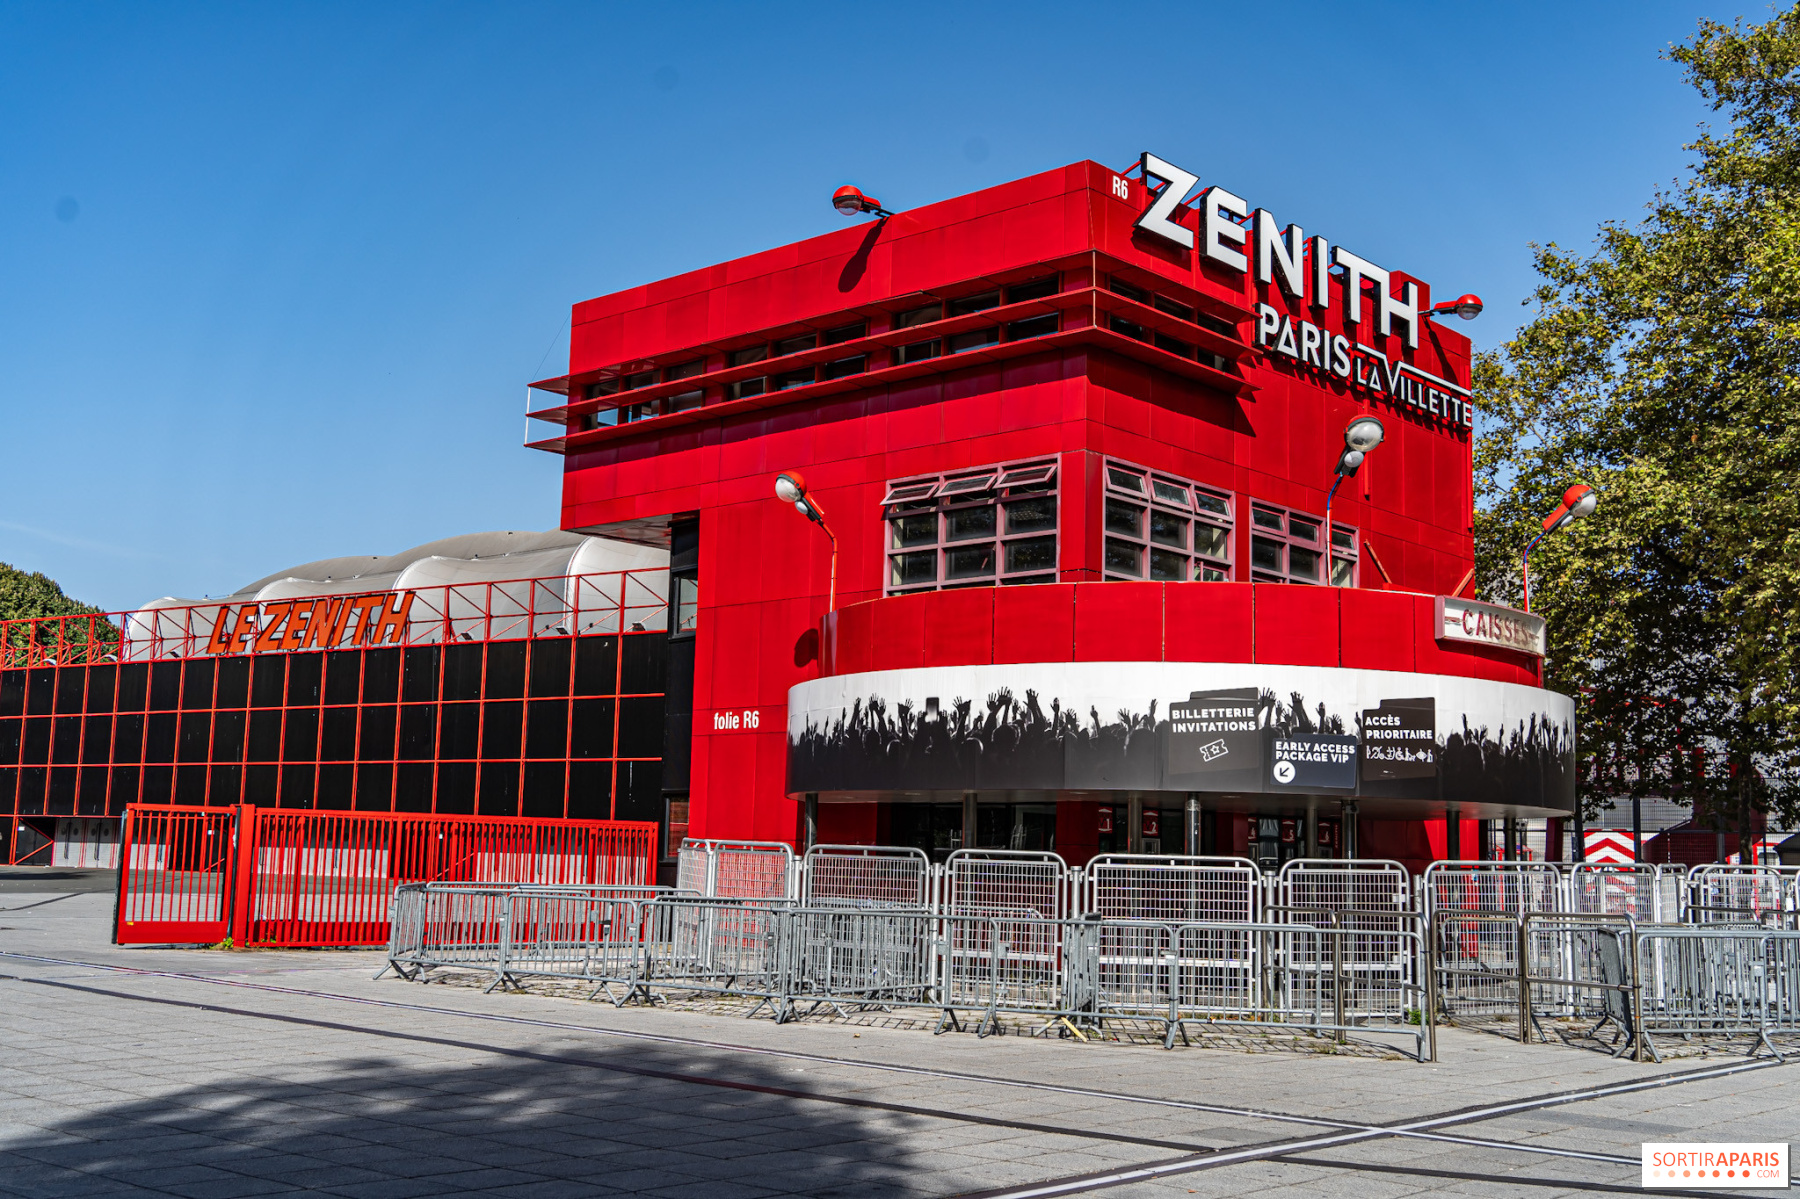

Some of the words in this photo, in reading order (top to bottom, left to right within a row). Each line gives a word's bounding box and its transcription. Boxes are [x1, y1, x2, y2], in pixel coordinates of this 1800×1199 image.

[1112, 175, 1129, 200] R6
[1133, 151, 1419, 350] ZENITH
[1255, 302, 1352, 378] PARIS
[1354, 357, 1382, 391] LA
[1380, 352, 1472, 428] VILLETTE
[206, 603, 259, 654] LE
[254, 591, 417, 652] ZENITH
[1462, 608, 1529, 647] CAISSES
[714, 711, 740, 730] folie
[743, 710, 760, 729] R6
[1172, 707, 1255, 719] BILLETTERIE
[1365, 714, 1401, 726] ACCÈS
[1172, 721, 1257, 733] INVITATIONS
[1366, 729, 1433, 740] PRIORITAIRE
[1275, 741, 1312, 752] EARLY
[1313, 743, 1356, 754] ACCESS
[1275, 751, 1328, 762] PACKAGE
[1330, 753, 1349, 763] VIP
[1151, 821, 1157, 832] 2
